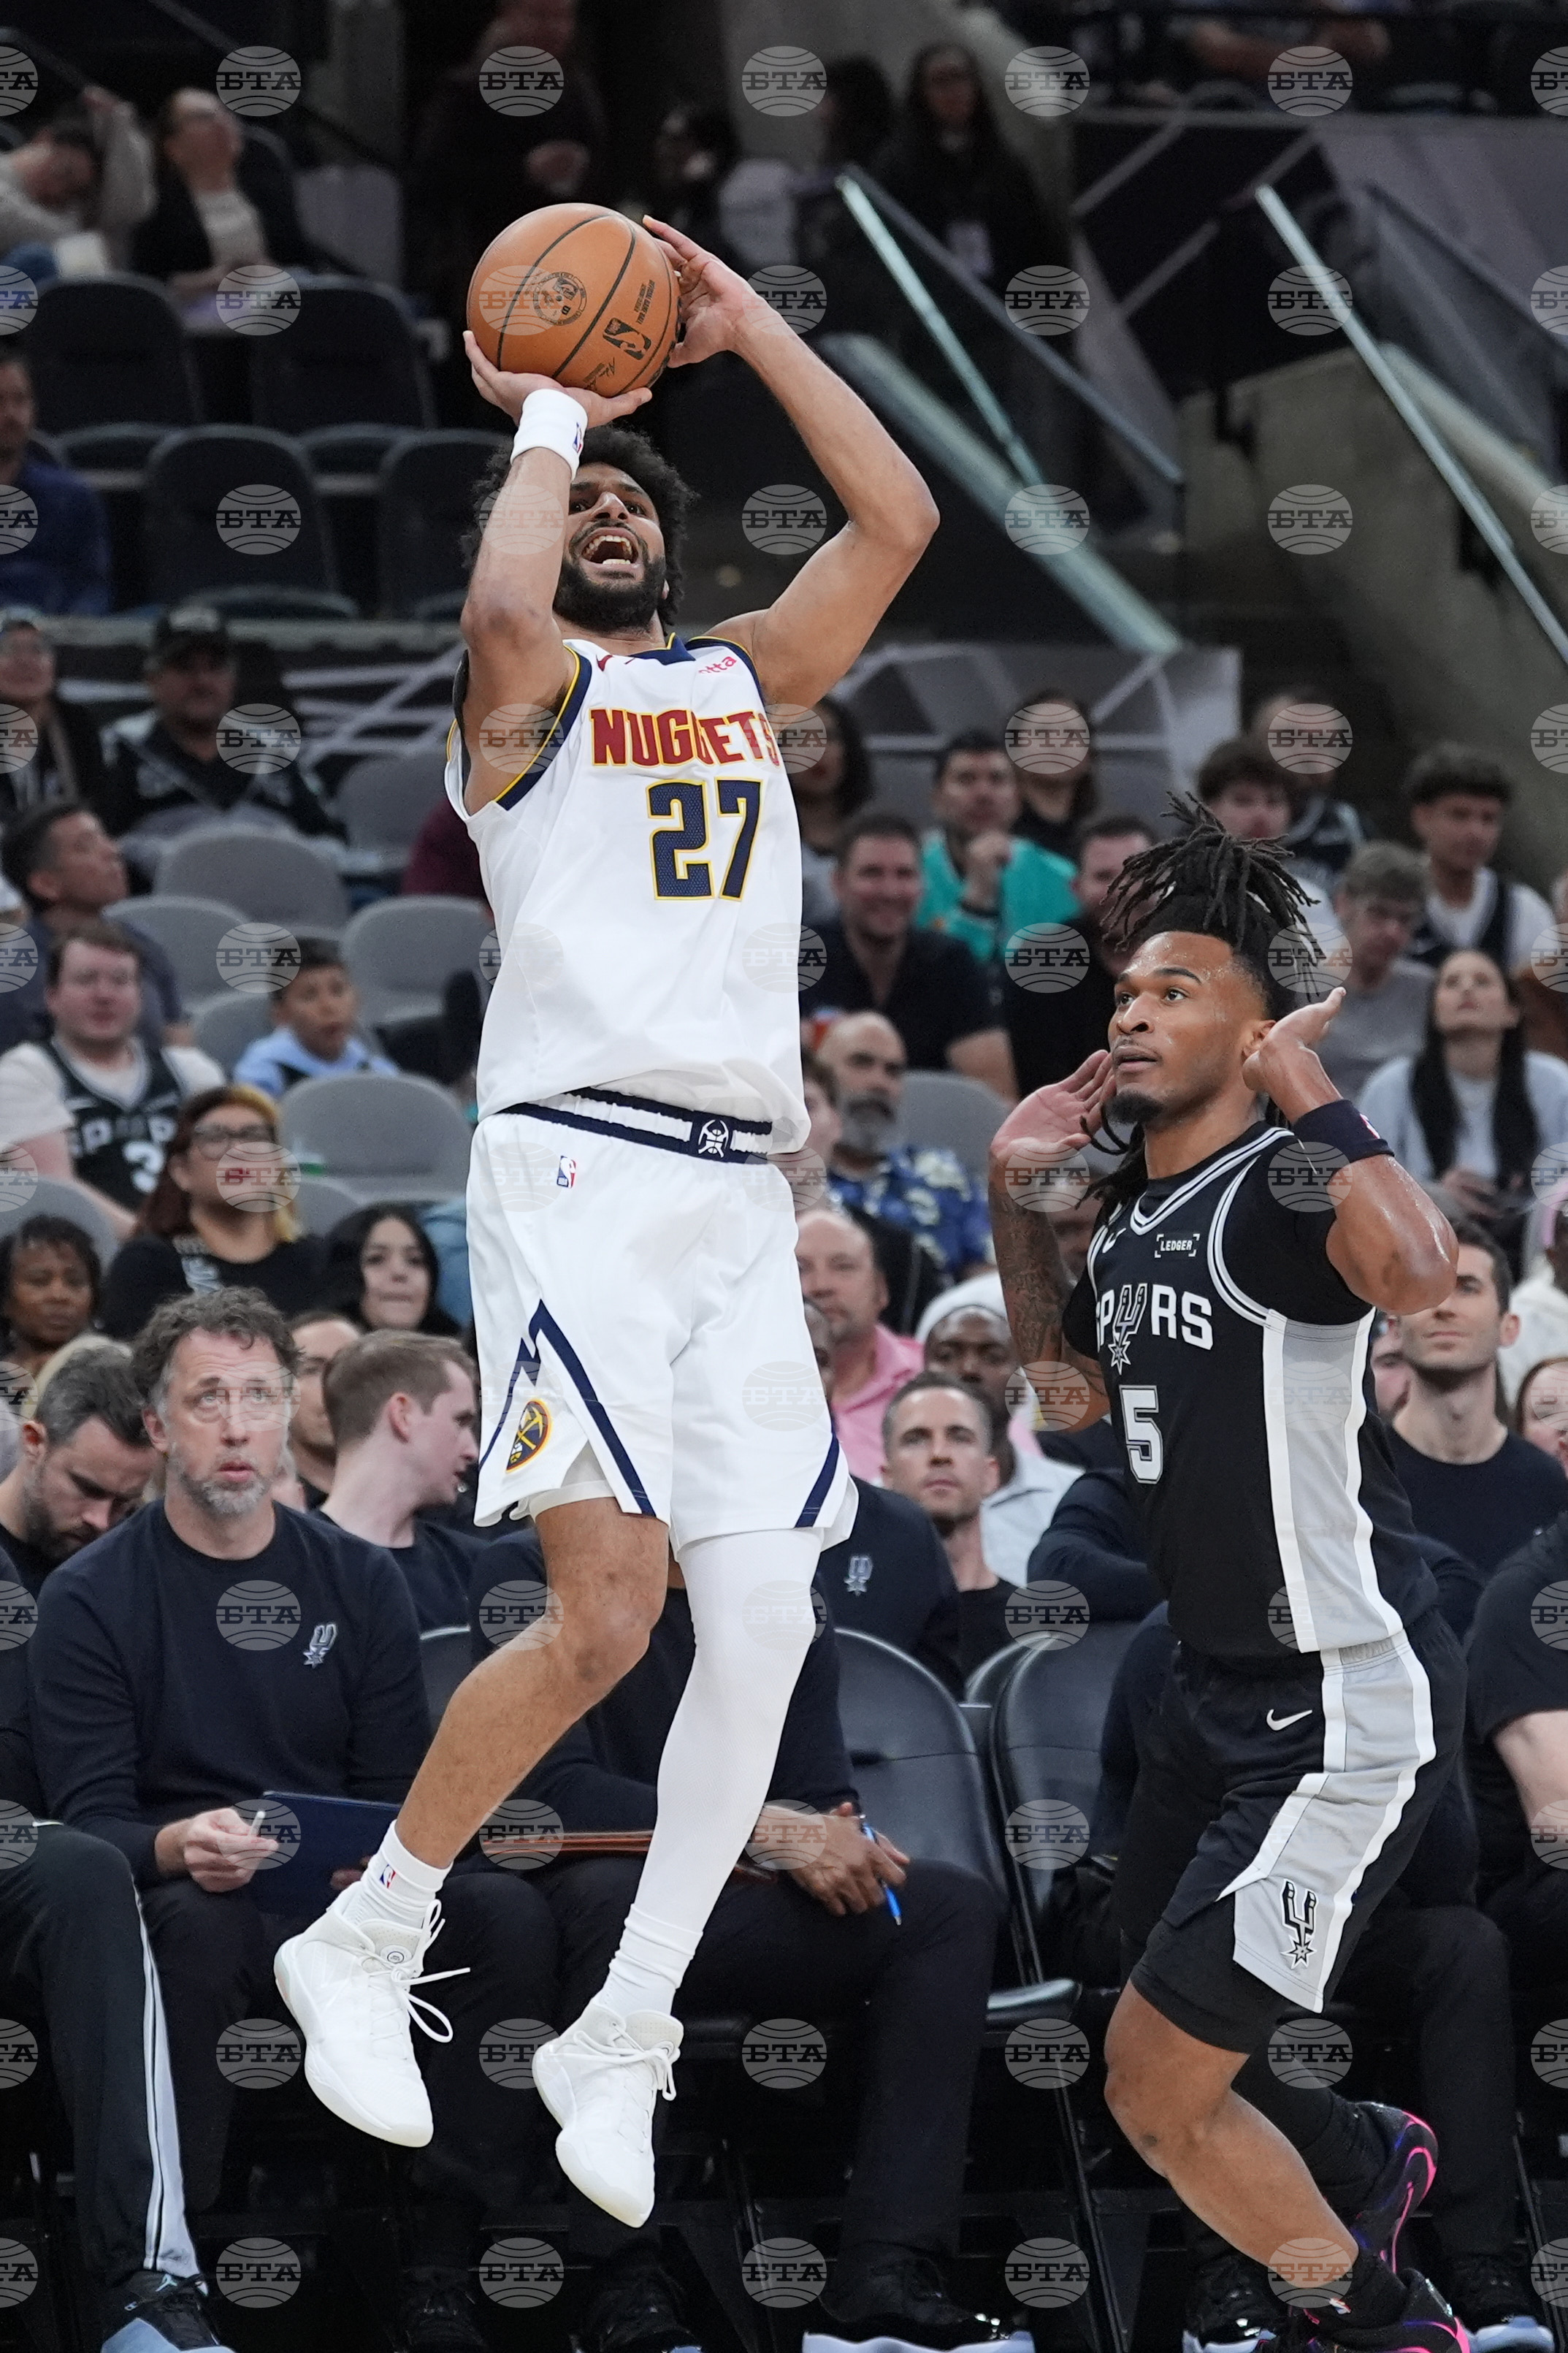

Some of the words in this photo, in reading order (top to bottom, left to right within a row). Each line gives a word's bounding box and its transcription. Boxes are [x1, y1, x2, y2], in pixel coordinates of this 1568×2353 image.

[646, 776, 763, 901] 27
[1160, 1239, 1193, 1251] LEDGER
[1095, 1283, 1213, 1375] PURS
[1119, 1384, 1163, 1484] 5
